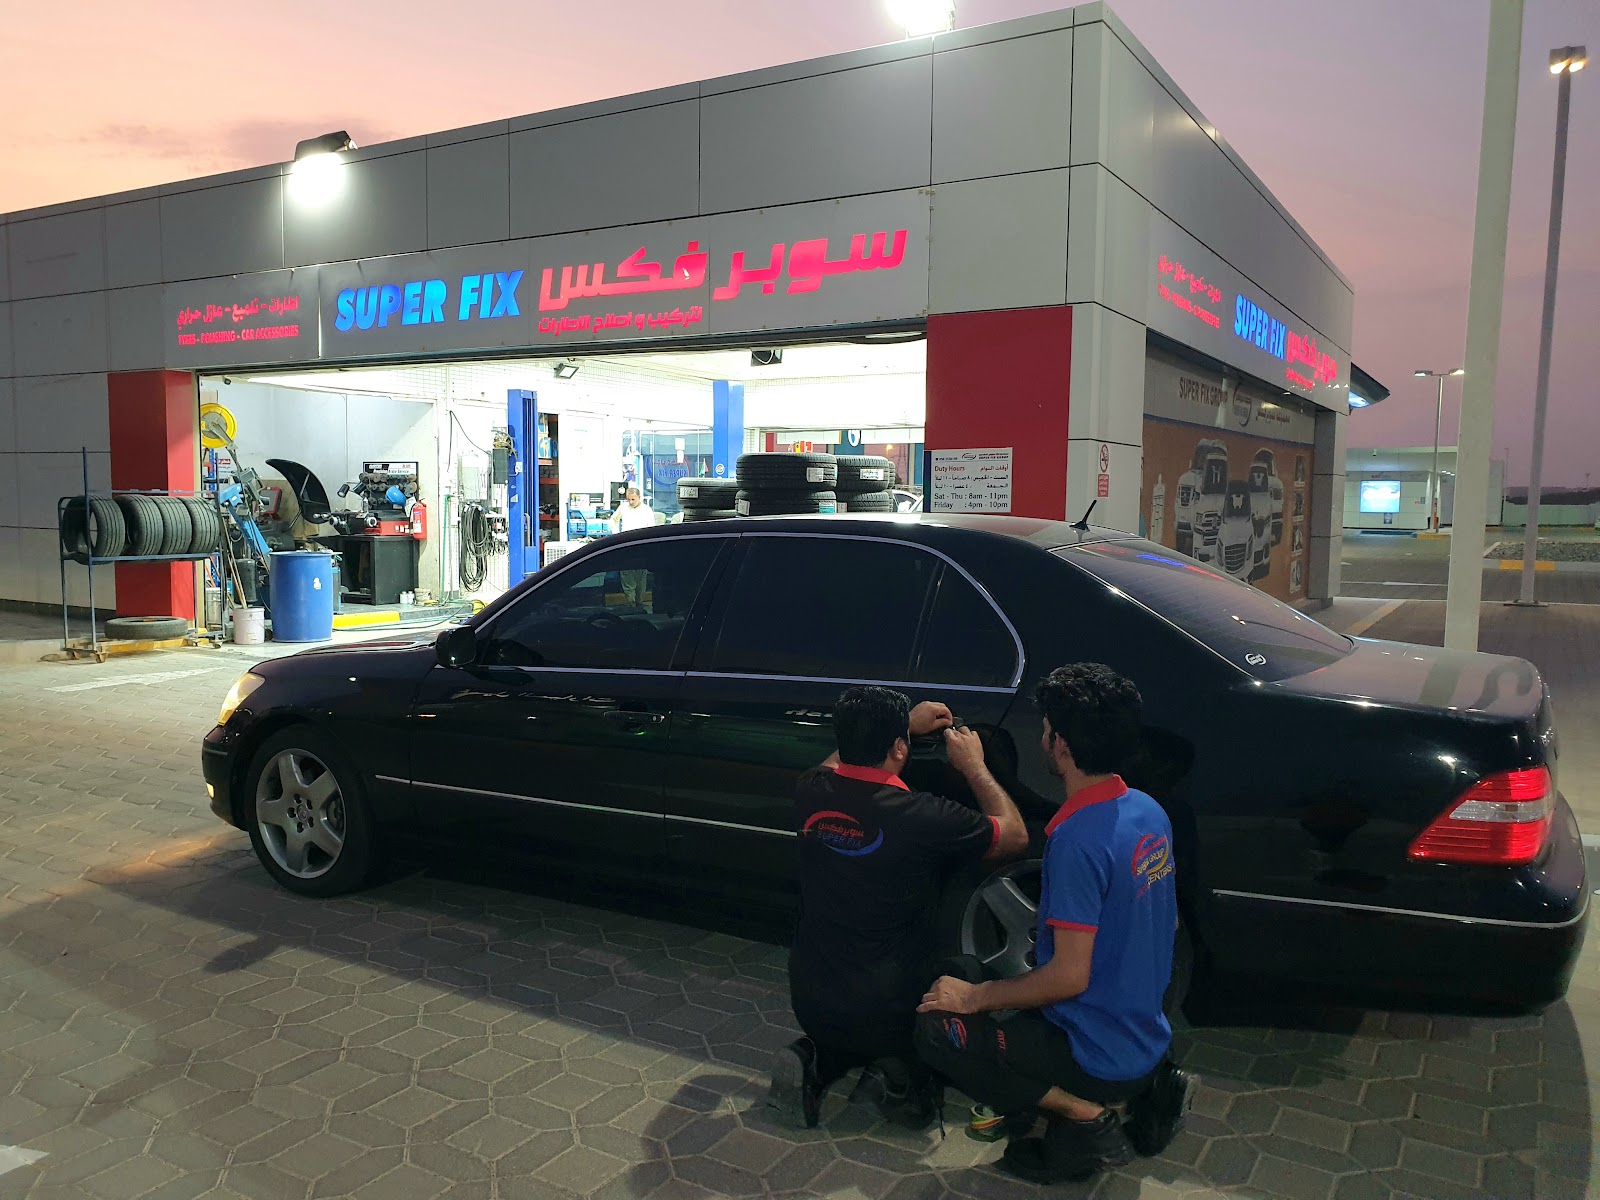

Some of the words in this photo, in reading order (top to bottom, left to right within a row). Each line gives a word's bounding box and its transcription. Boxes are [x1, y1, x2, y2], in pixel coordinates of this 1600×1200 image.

[539, 241, 708, 312] فكس
[712, 230, 908, 300] سوبر
[334, 279, 447, 332] SUPER
[458, 270, 524, 321] FIX
[634, 314, 646, 330] و
[241, 329, 254, 341] CAR
[255, 325, 299, 340] ACCESSORIES
[1234, 294, 1268, 350] SUPER
[1270, 317, 1286, 360] FIX
[1179, 376, 1199, 402] SUPER
[1200, 383, 1210, 405] FIX
[816, 830, 845, 843] SUPER
